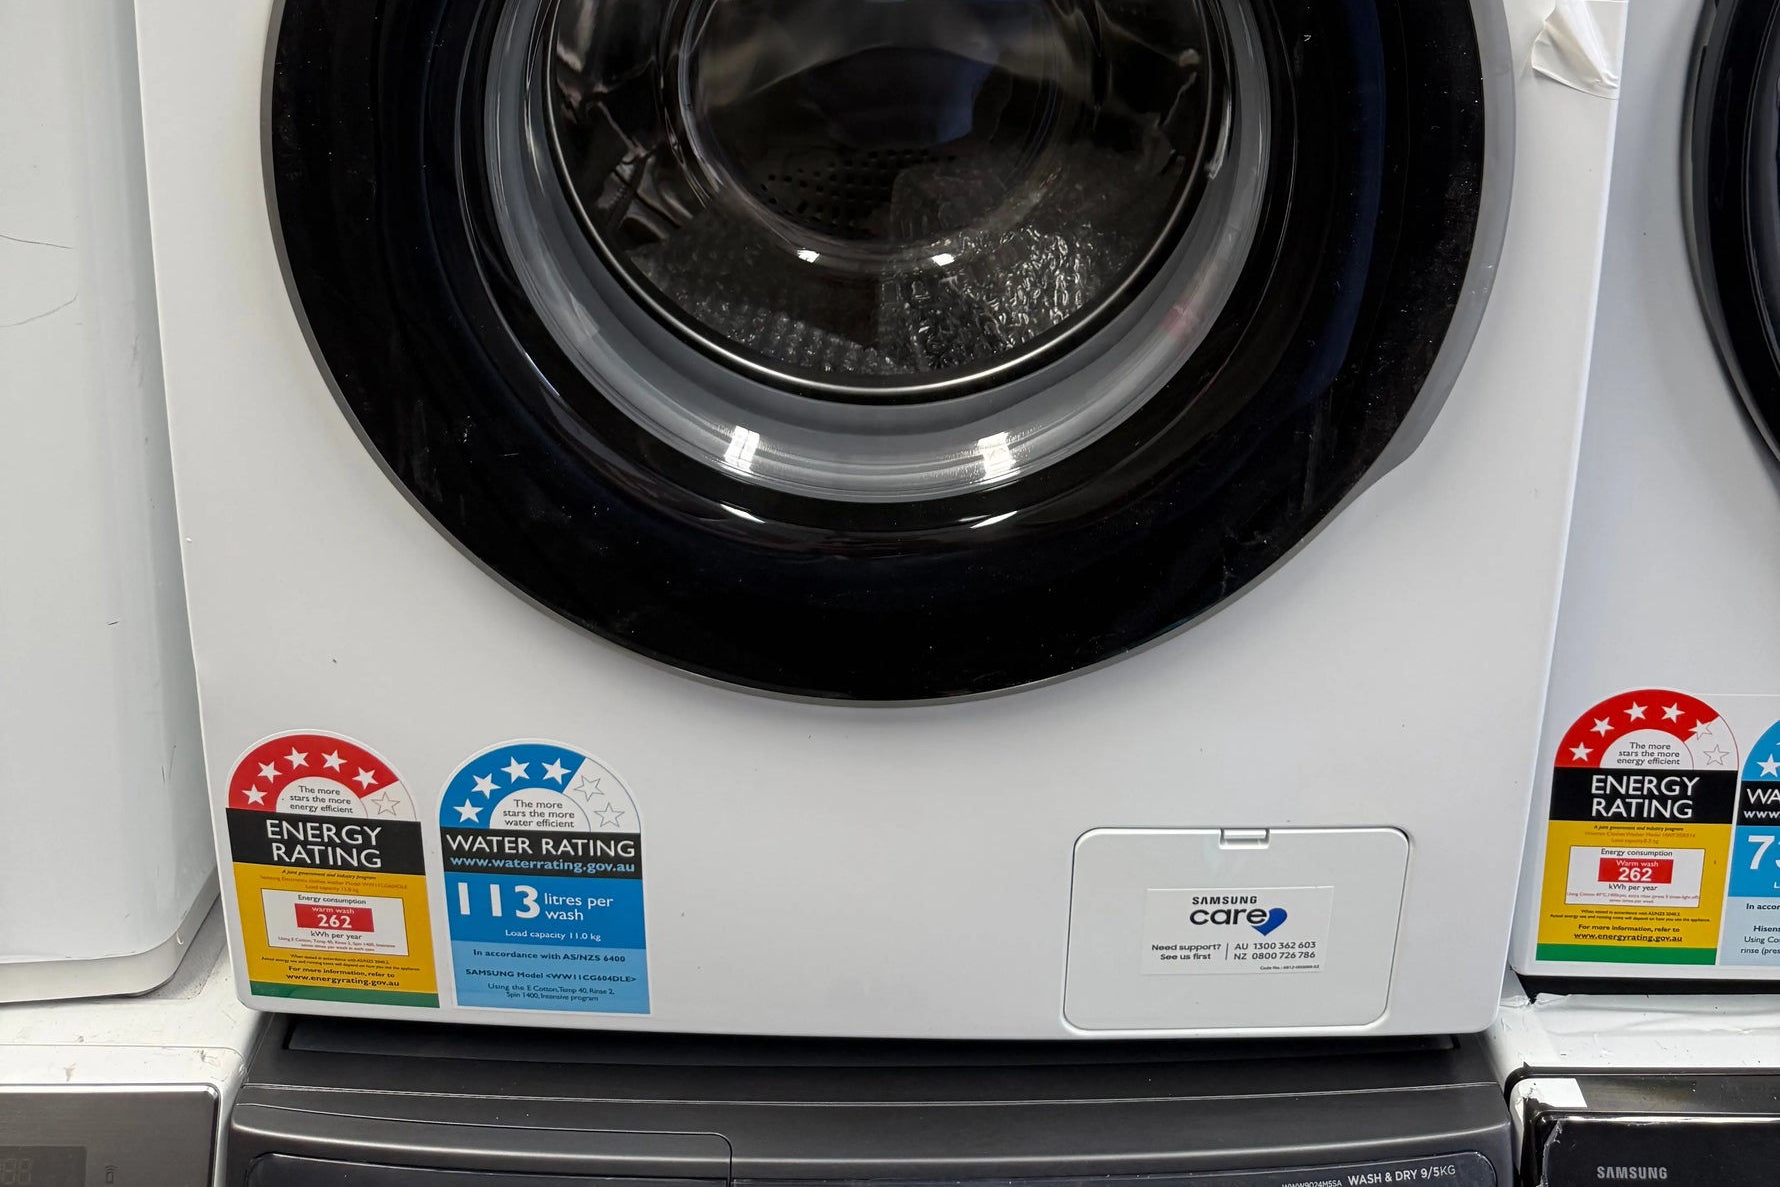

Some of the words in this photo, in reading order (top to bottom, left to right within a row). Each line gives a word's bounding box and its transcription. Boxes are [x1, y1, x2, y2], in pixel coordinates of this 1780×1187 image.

[1630, 742, 1645, 750] The
[1648, 743, 1671, 751] more
[1641, 750, 1655, 758] the
[1616, 758, 1645, 766] energy
[1647, 757, 1680, 765] efficient
[298, 785, 316, 794] The
[317, 787, 340, 795] more
[1591, 775, 1700, 796] ENERGY
[289, 794, 310, 802] stars
[312, 795, 326, 803] the
[290, 804, 318, 813] energy
[320, 804, 353, 813] efficient
[513, 799, 533, 809] The
[536, 801, 563, 809] more
[1591, 798, 1693, 819] RATING
[503, 809, 526, 818] stars
[529, 809, 545, 819] the
[548, 811, 575, 819] more
[505, 819, 534, 827] water
[536, 819, 575, 828] efficient
[266, 819, 382, 845] ENERGY
[446, 834, 533, 855] WATER
[541, 838, 635, 858] RATING
[271, 842, 382, 868] RATING
[1601, 848, 1625, 857] Energy
[1627, 849, 1673, 858] consumption
[1748, 835, 1780, 869] 7
[450, 857, 635, 874] www.waterrating.gov.au
[1641, 860, 1659, 868] wash
[1618, 867, 1653, 882] 262
[1608, 883, 1627, 891] kWh
[298, 894, 321, 902] Energy
[323, 896, 367, 905] consumption
[457, 882, 541, 919] 113
[544, 893, 582, 906] litres
[587, 897, 614, 910] per
[1192, 895, 1258, 905] SAMSUNG
[545, 909, 584, 921] wash
[1189, 908, 1268, 926] care
[317, 914, 352, 929] 262
[310, 930, 329, 938] kWh
[331, 932, 345, 940] per
[505, 929, 527, 938] Load
[530, 931, 566, 941] capacity
[569, 932, 588, 940] 11.0
[590, 933, 602, 942] kg
[1574, 932, 1683, 943] www.energyrating.gov.au
[1253, 942, 1277, 950] 1300
[1278, 942, 1296, 950] 362
[1297, 941, 1316, 949] 603
[1744, 936, 1765, 945] Using
[1767, 936, 1780, 944] Co
[1179, 943, 1222, 952] support?
[485, 950, 538, 959] accordance
[540, 952, 561, 960] with
[603, 955, 626, 963] 6400
[1160, 953, 1178, 961] See
[1251, 952, 1277, 960] 0800
[1298, 951, 1316, 959] 786
[323, 968, 368, 977] information,
[465, 968, 515, 978] SAMSUNG
[517, 970, 544, 979] Model
[286, 974, 400, 987] www.energyrating.gov.au
[487, 983, 510, 991] Using
[570, 994, 599, 1002] program
[1348, 1174, 1382, 1186] WASH
[1385, 1172, 1393, 1183] &
[1395, 1169, 1417, 1181] DRY
[1420, 1164, 1456, 1178] 9/5KG
[1597, 1166, 1668, 1180] SAMSUNG
